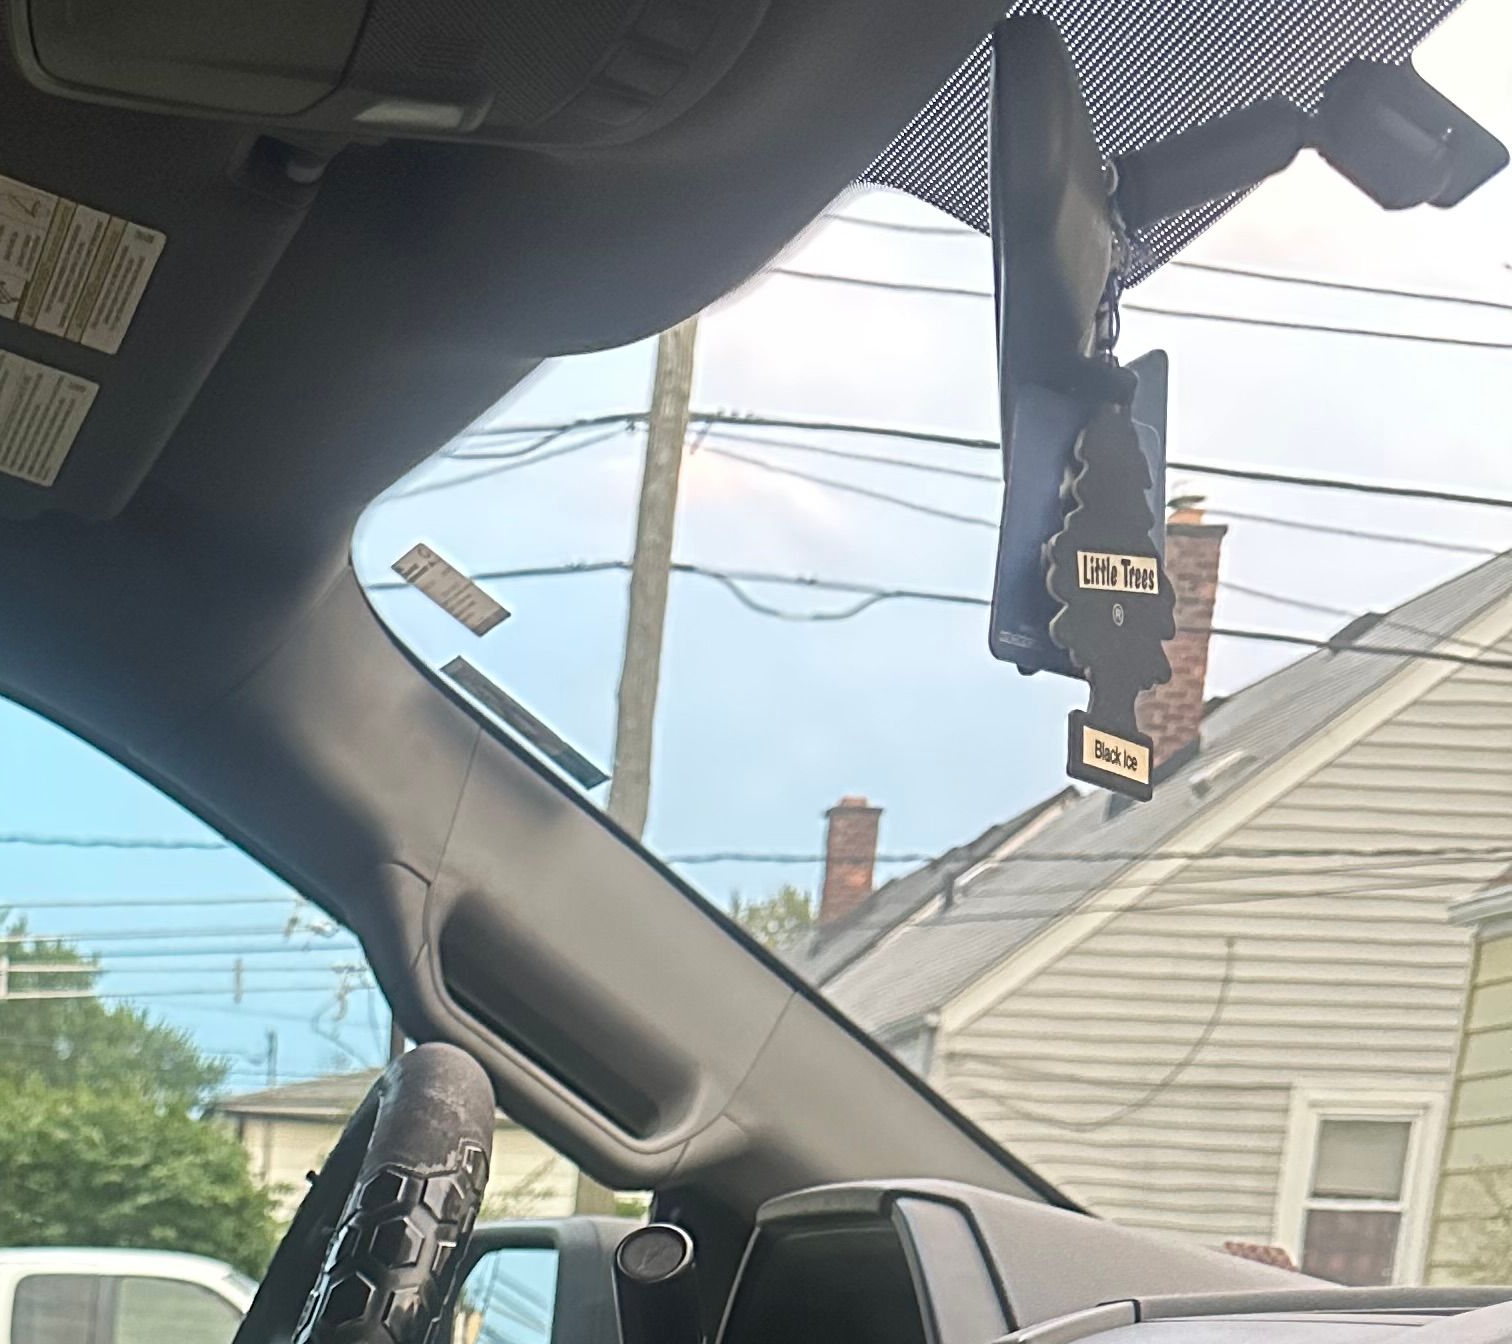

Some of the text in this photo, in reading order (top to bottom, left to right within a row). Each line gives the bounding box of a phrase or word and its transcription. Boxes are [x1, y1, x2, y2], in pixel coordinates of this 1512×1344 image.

[1083, 554, 1155, 591] Little Trees
[1095, 739, 1138, 772] Black Ice
